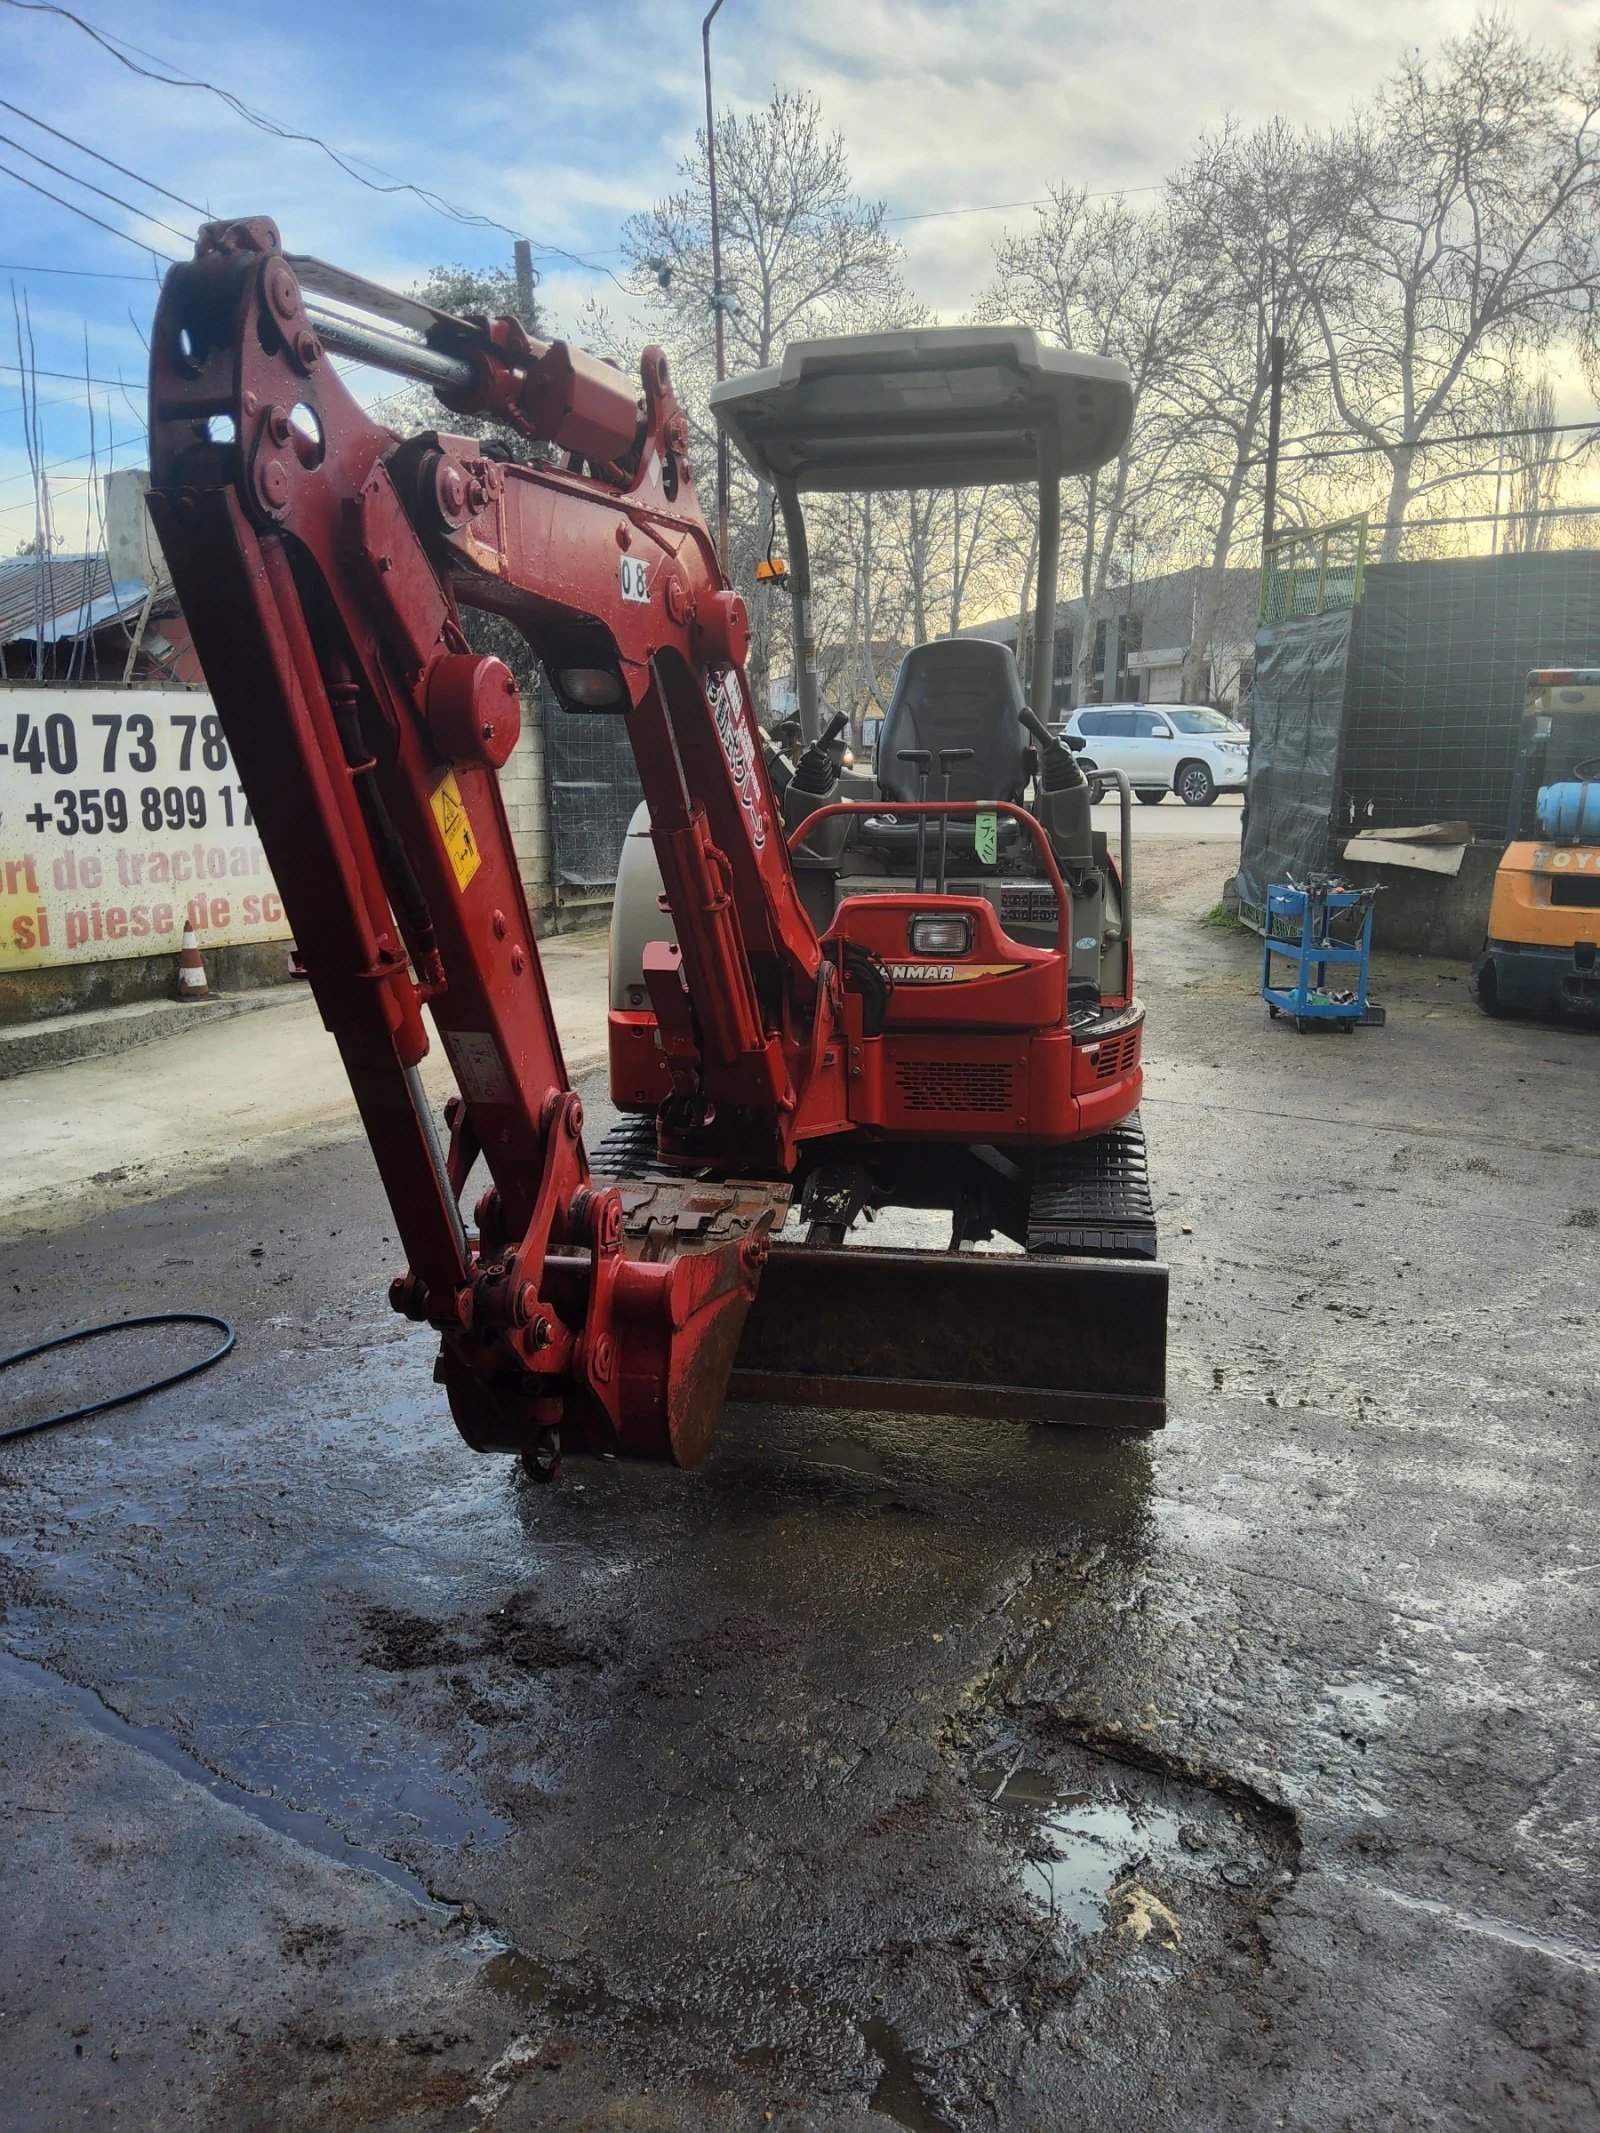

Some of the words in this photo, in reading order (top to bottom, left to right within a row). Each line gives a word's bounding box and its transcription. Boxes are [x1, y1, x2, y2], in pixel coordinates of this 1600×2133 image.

[622, 559, 650, 599] 0.8
[92, 714, 157, 773] 73
[170, 714, 227, 771] 78
[26, 788, 128, 836] +359
[140, 785, 207, 832] 899
[0, 852, 40, 895] rt
[52, 849, 103, 891] de
[115, 843, 272, 886] tractoar
[1534, 850, 1600, 869] TOY
[12, 906, 50, 949] si
[64, 902, 174, 949] piese
[187, 892, 231, 932] de
[242, 893, 289, 925] sc
[1078, 938, 1093, 948] OK
